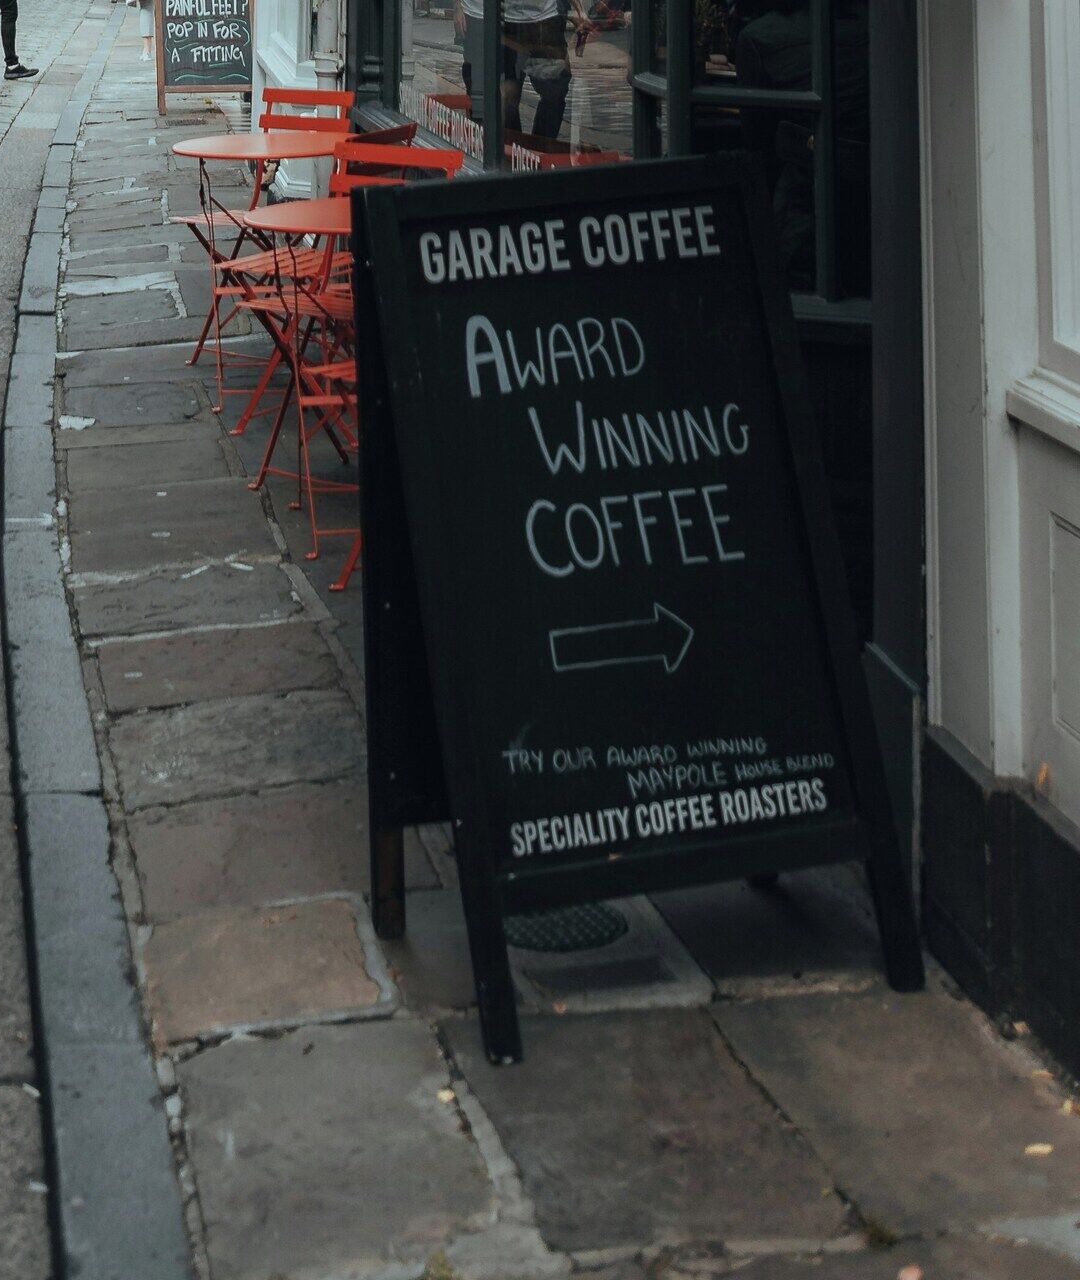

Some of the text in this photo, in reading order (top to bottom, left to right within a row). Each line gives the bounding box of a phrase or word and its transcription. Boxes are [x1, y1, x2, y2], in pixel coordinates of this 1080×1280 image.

[167, 21, 242, 40] POP IN FOR
[171, 45, 246, 67] A FITTING
[420, 205, 720, 284] GARAGE COFFEE
[465, 314, 645, 398] AWARD
[528, 400, 749, 476] WINNING
[525, 484, 746, 578] COFFEE
[502, 737, 768, 776] TRY OUR AWARD WINNING
[625, 762, 728, 799] MAYPOLE
[733, 759, 783, 781] HOUSE
[510, 777, 828, 858] SPECIALITY COFFEE ROASTERS
